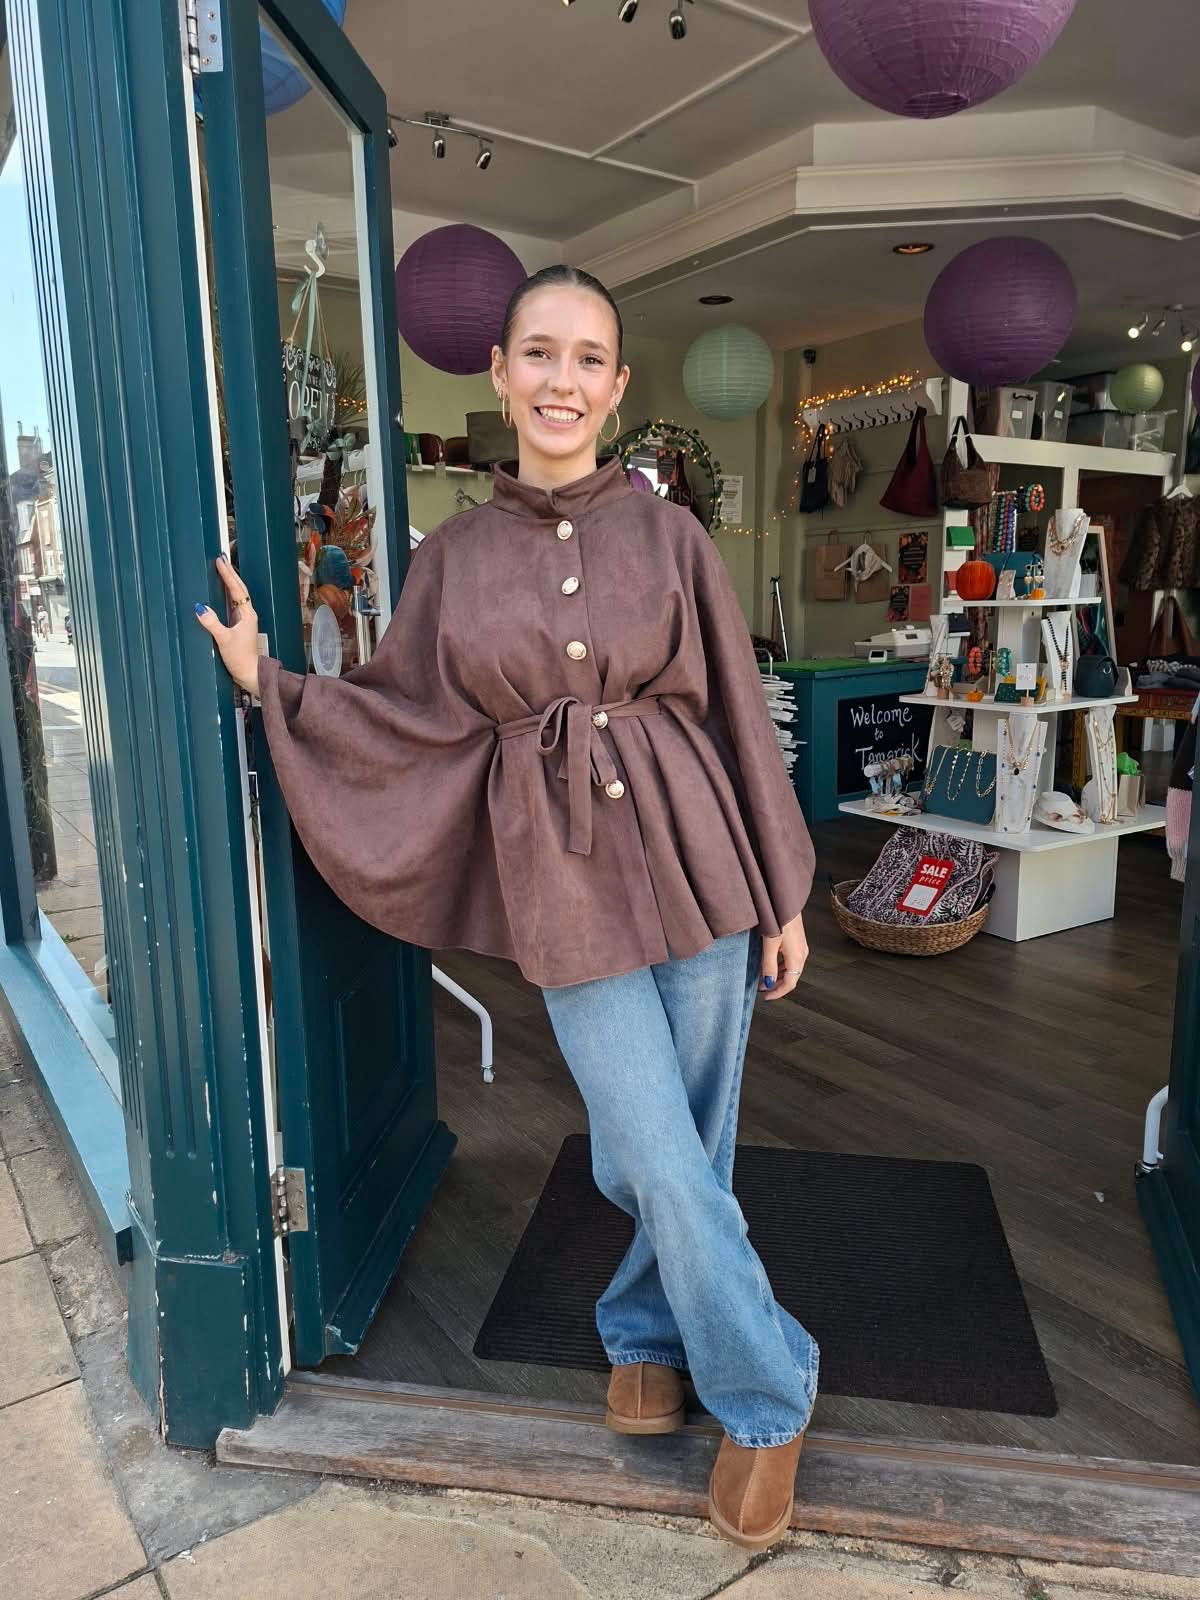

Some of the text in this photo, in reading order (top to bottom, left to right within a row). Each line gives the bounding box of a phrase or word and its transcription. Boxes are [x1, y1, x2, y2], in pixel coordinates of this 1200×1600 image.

[850, 704, 913, 728] Welcome
[874, 728, 884, 741] to
[920, 864, 949, 878] SALE
[918, 876, 941, 885] price
